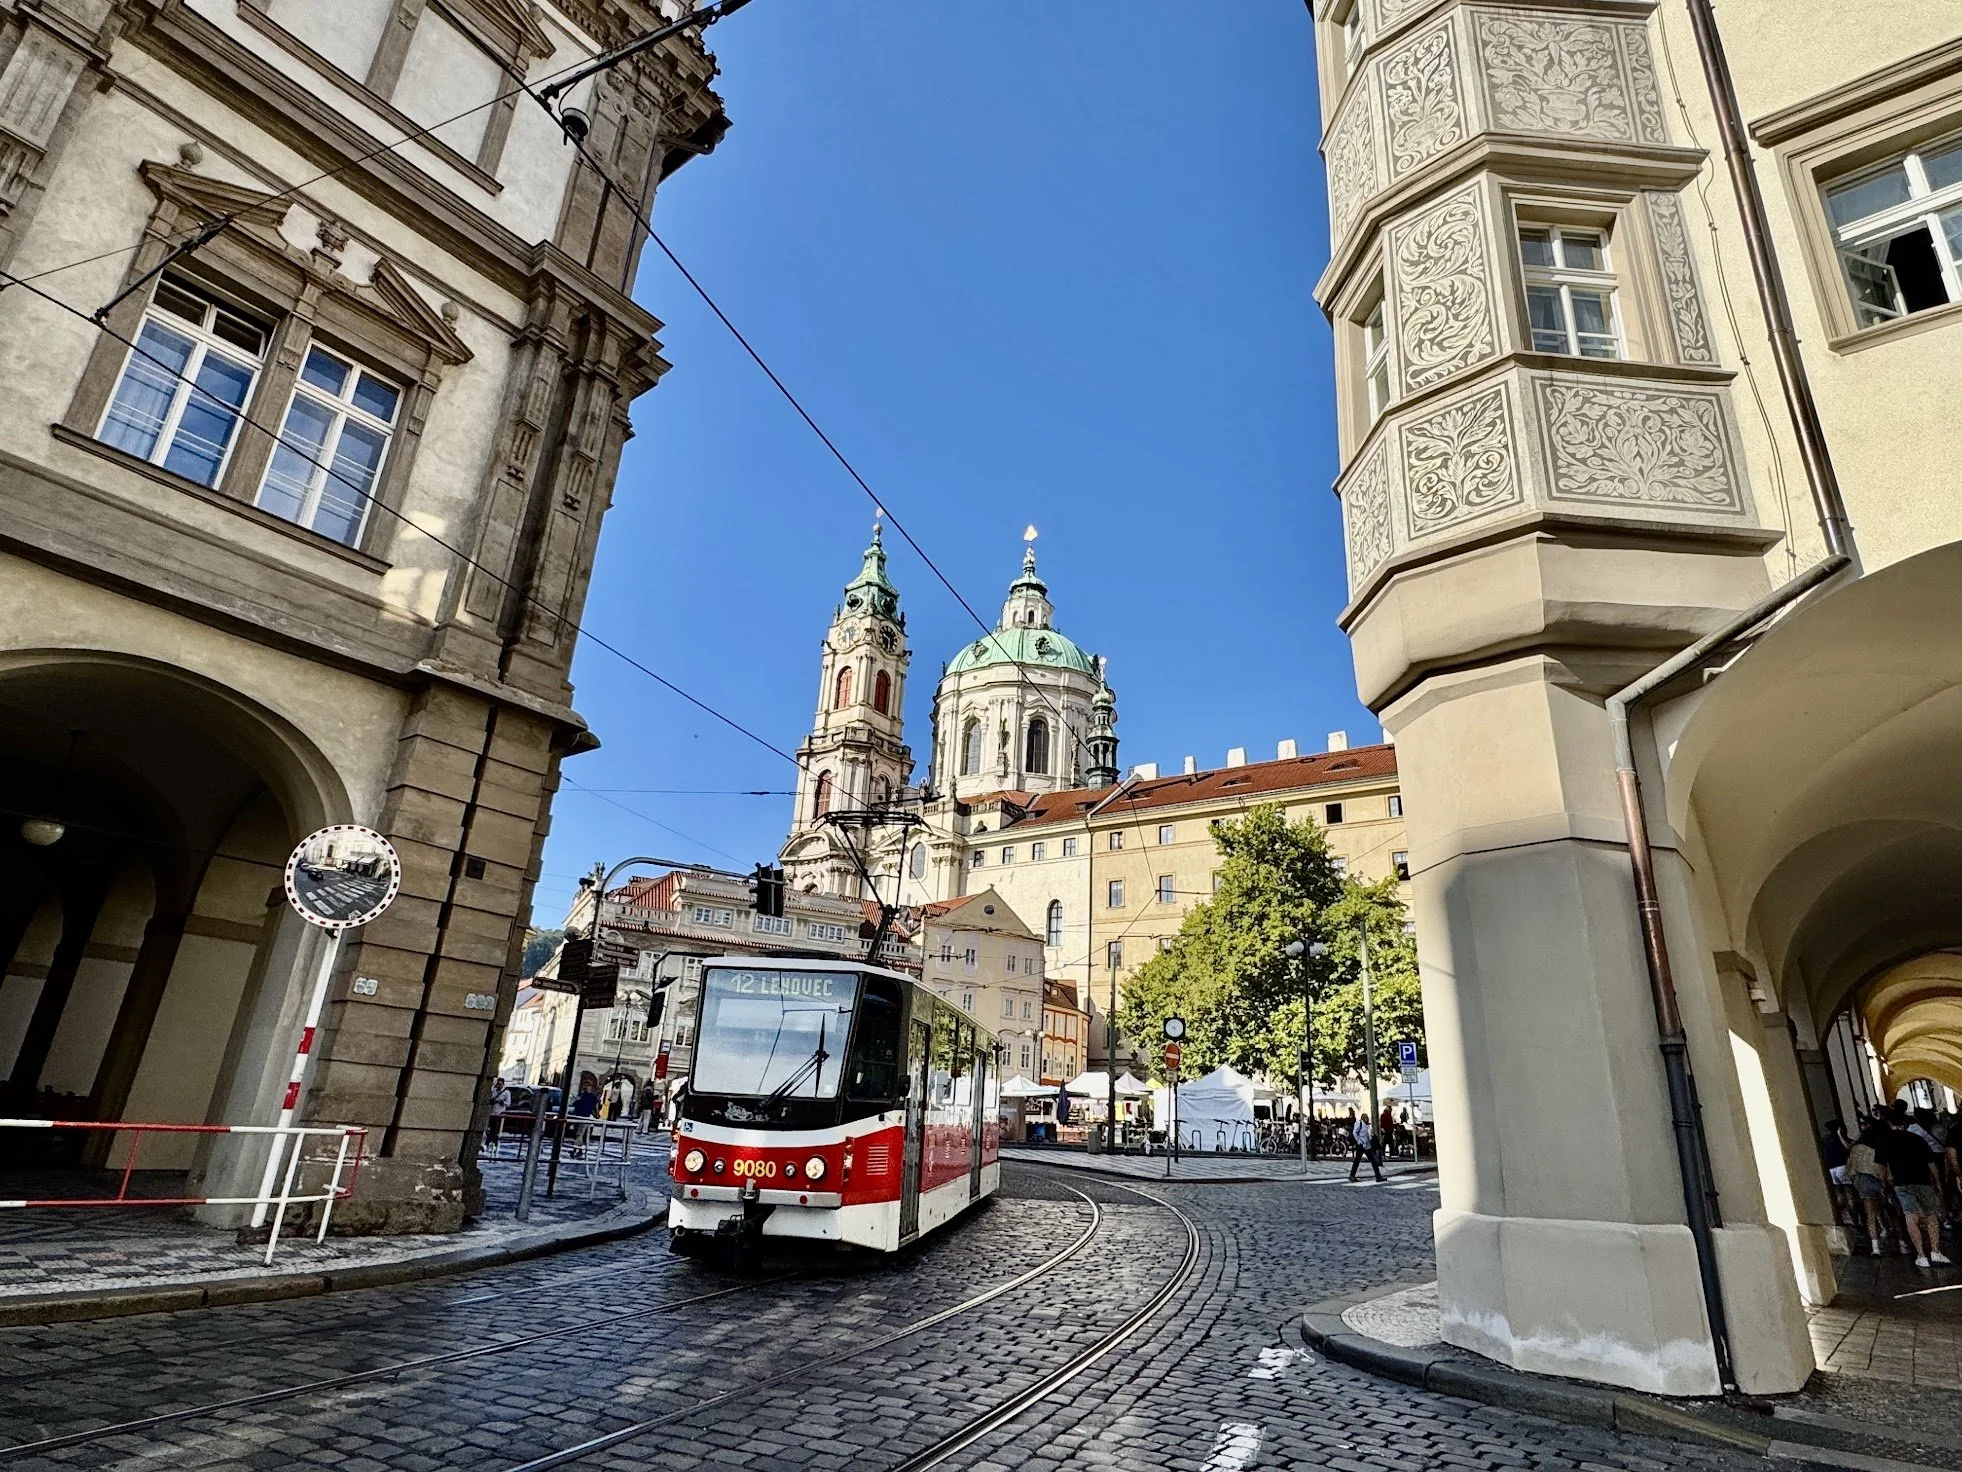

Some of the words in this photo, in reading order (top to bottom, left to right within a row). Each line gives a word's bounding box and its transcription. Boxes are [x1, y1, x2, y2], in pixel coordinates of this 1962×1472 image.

[731, 973, 755, 994] 12
[1402, 1045, 1413, 1059] P
[733, 1159, 777, 1178] 9080
